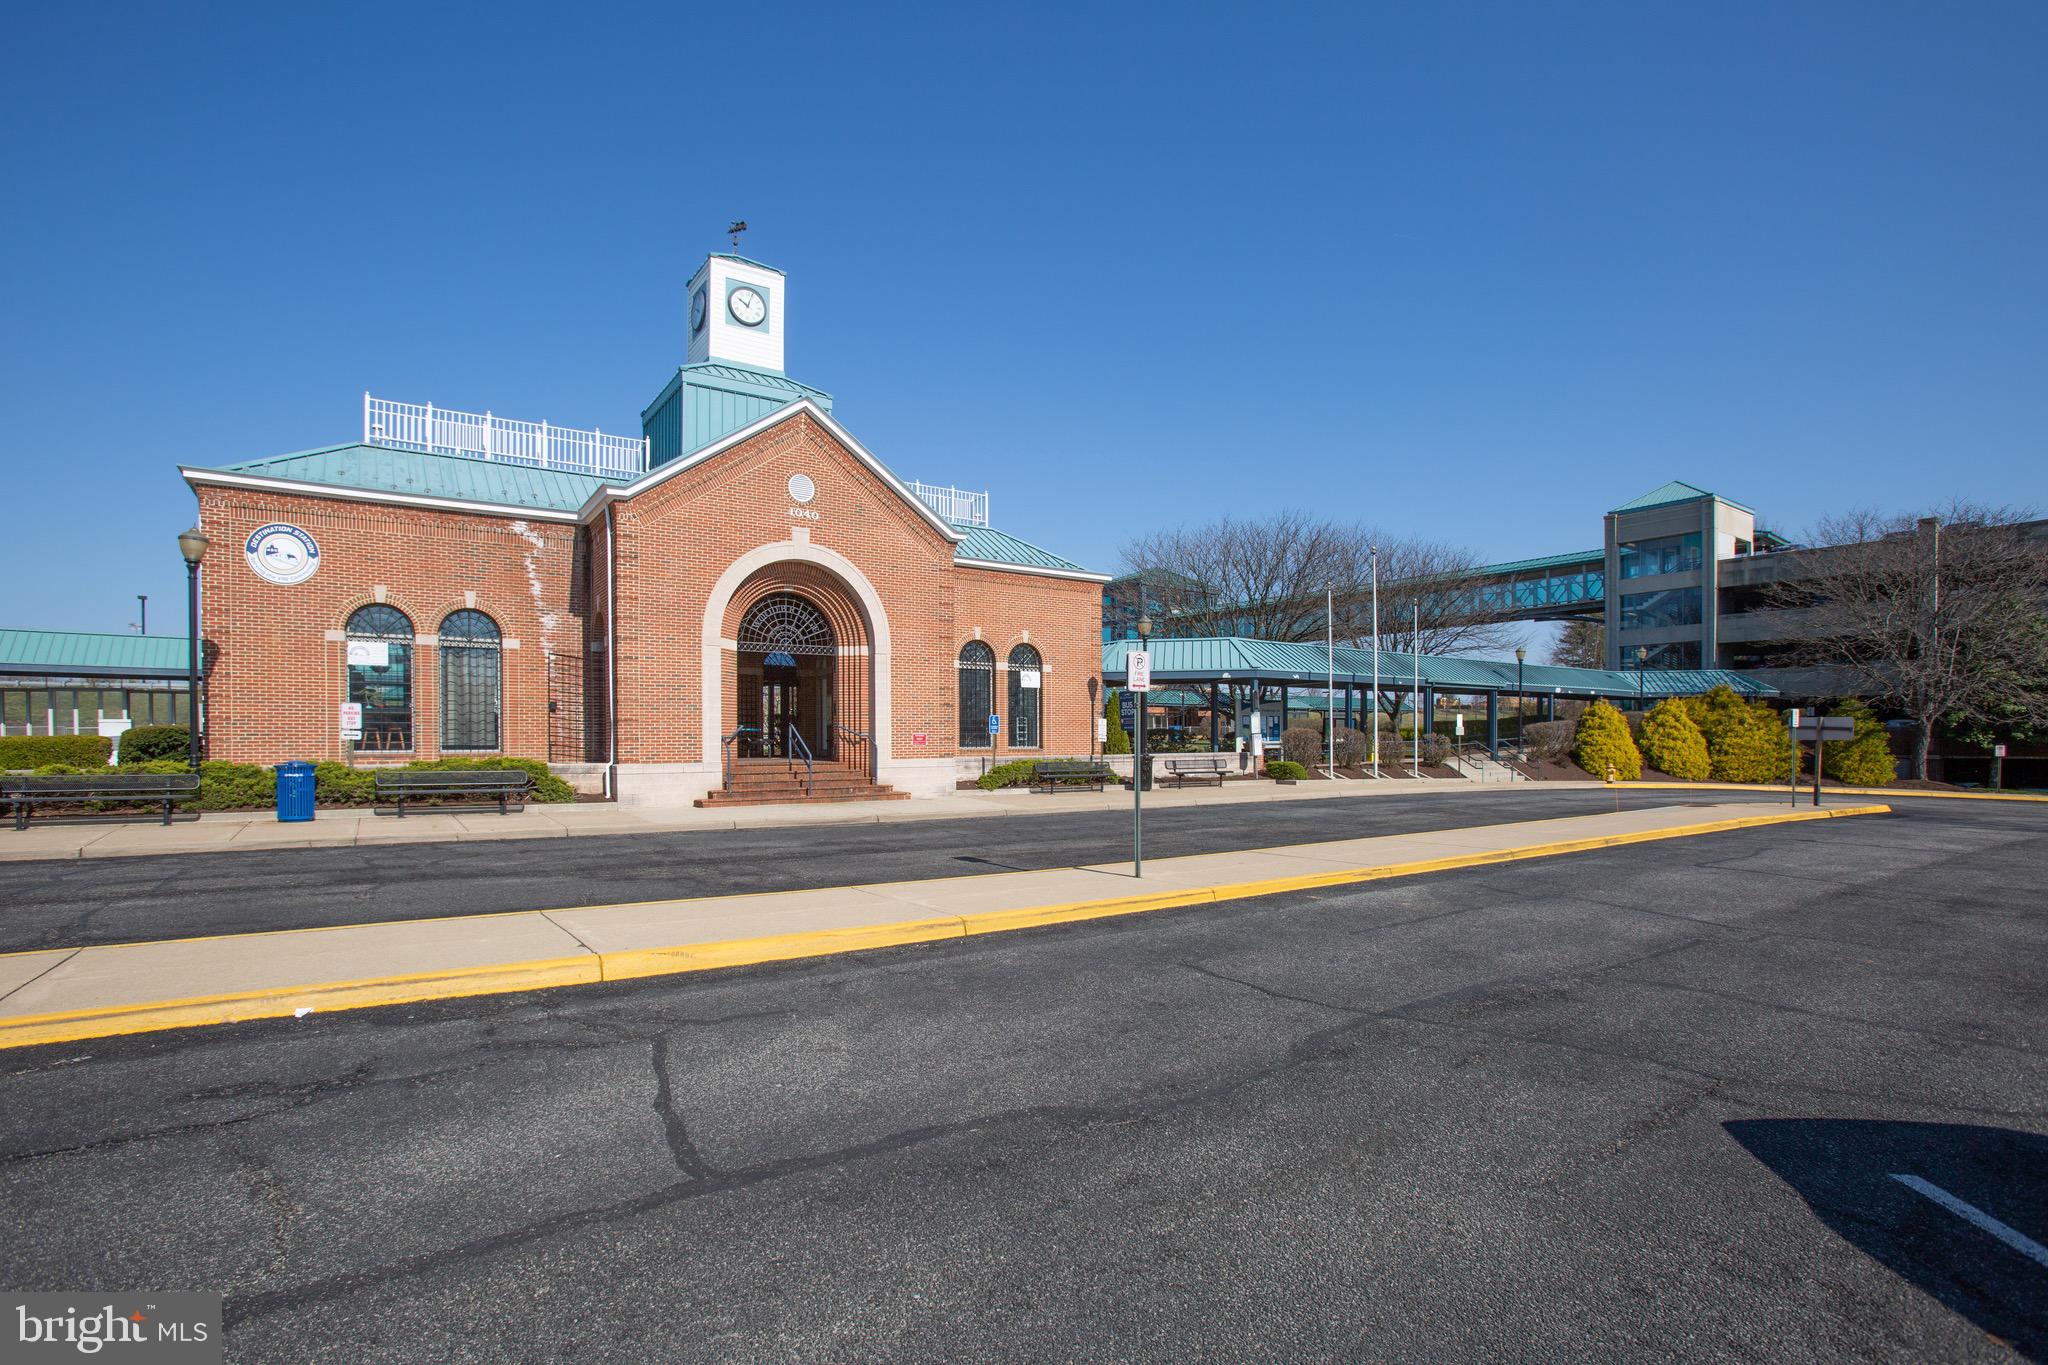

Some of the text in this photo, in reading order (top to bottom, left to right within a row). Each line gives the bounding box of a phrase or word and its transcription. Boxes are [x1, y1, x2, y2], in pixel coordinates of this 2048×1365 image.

[790, 508, 819, 520] 1040
[250, 526, 316, 554] DESTINATION STATION
